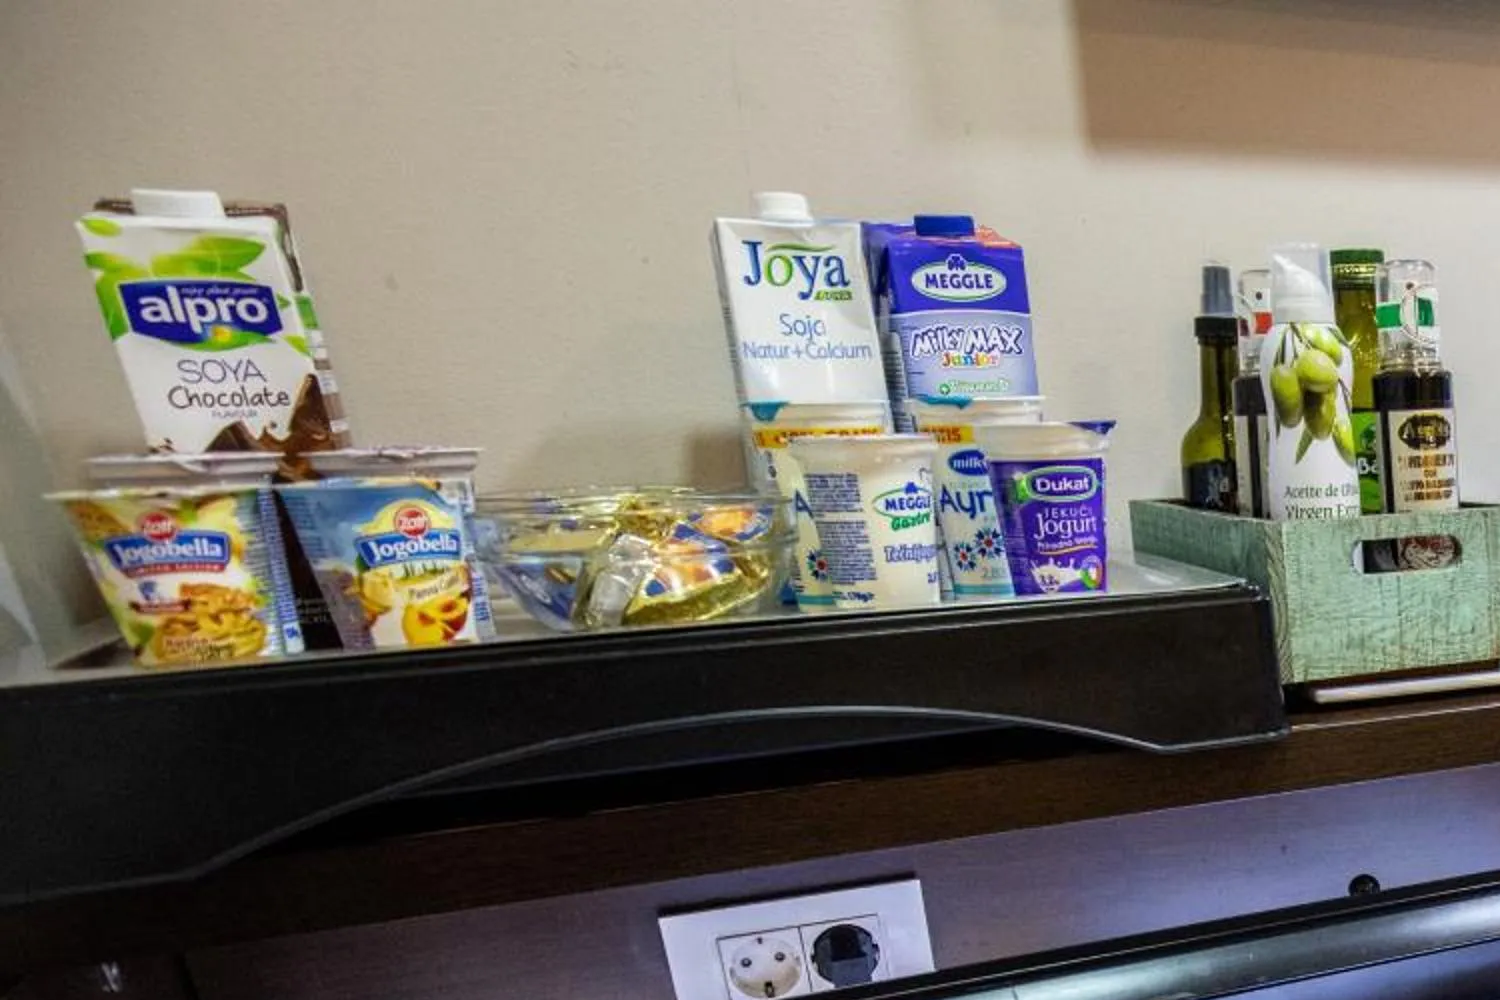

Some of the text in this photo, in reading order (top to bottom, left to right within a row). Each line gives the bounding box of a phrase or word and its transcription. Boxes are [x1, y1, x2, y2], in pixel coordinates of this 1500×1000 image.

[742, 240, 850, 300] Joya
[925, 273, 994, 289] MEGGLE
[139, 285, 269, 334] alpro
[177, 358, 267, 384] SOYA
[167, 385, 290, 409] Chocolate
[1036, 477, 1089, 492] Dukat
[1033, 513, 1097, 540] Jogurt
[369, 534, 457, 561] Jogobella
